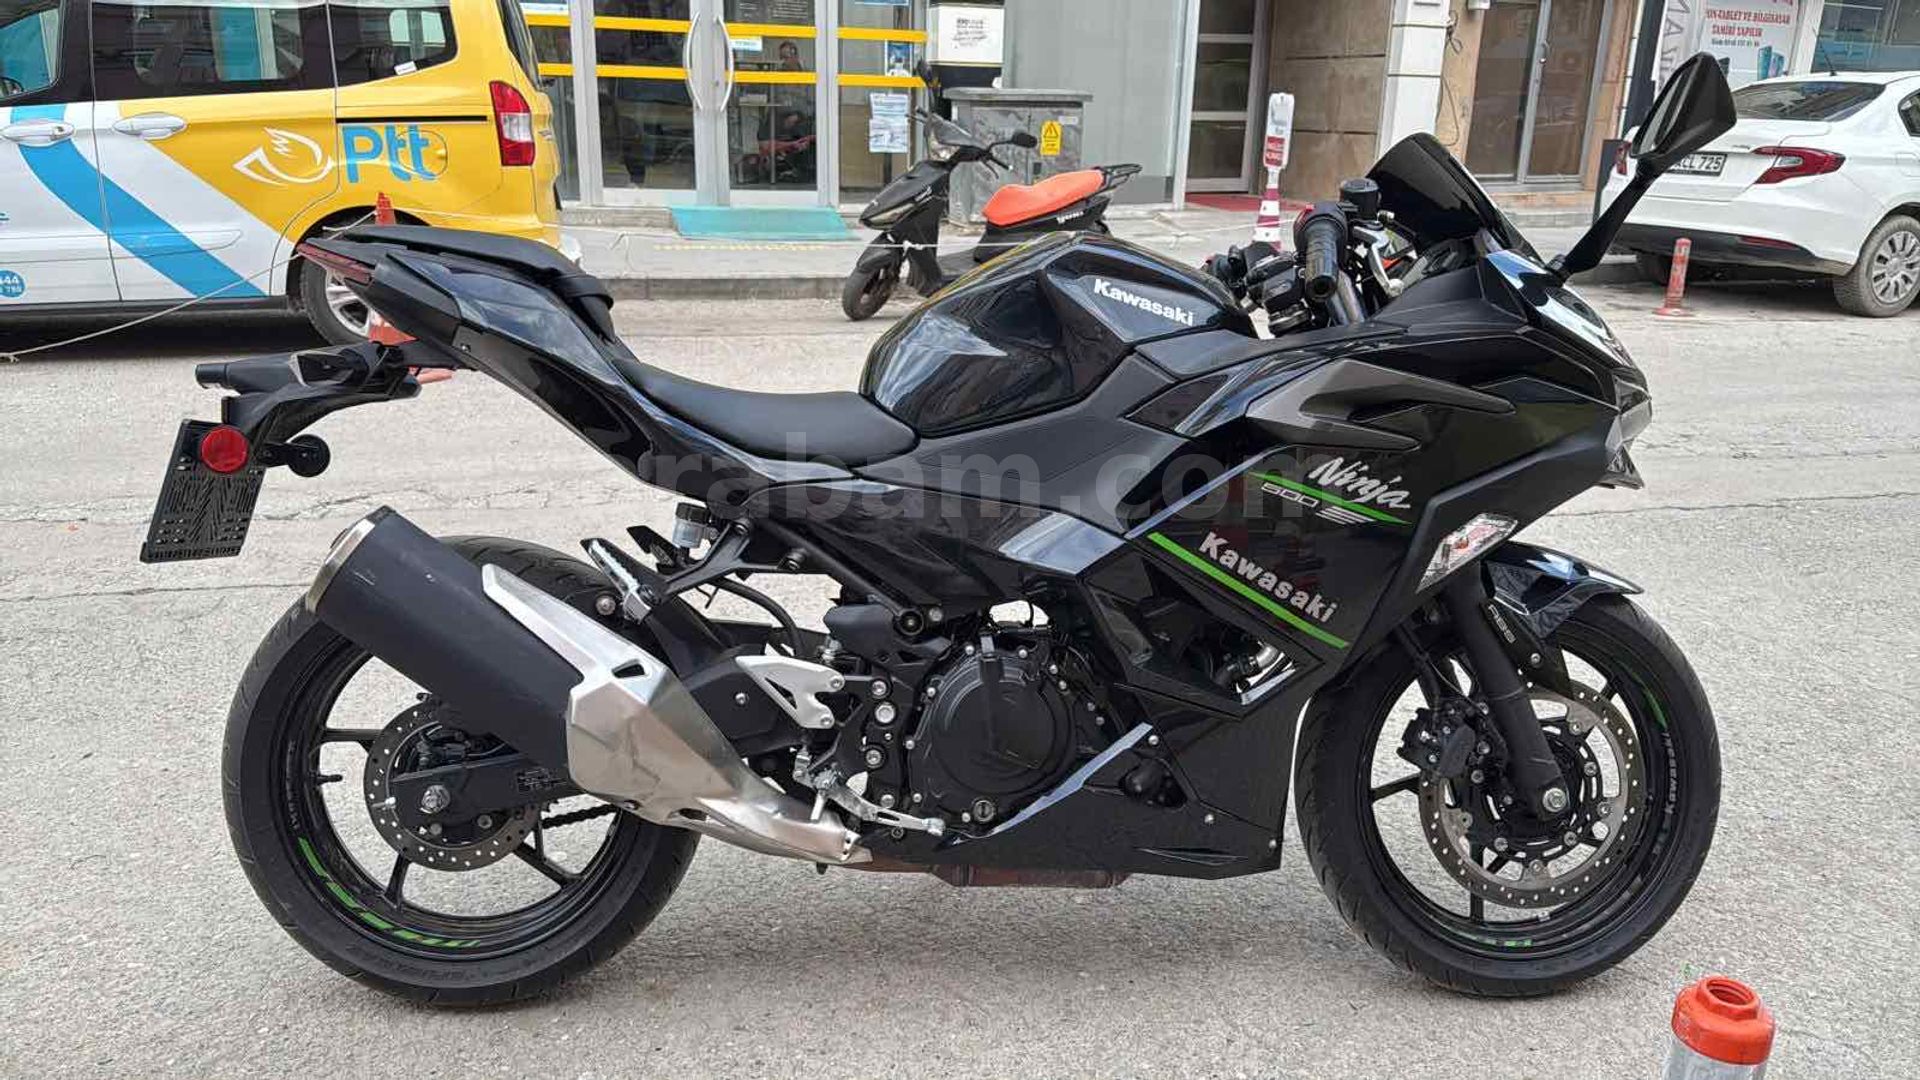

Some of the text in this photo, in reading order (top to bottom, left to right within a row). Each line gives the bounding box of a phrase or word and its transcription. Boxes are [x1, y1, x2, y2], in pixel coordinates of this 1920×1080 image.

[342, 124, 437, 183] Ptt
[1698, 156, 1722, 170] 725
[1094, 279, 1194, 327] Kawasaki
[1261, 482, 1320, 508] 500
[1308, 457, 1411, 509] Ninja
[1199, 532, 1338, 622] Kawasaki
[1488, 604, 1516, 644] ABS
